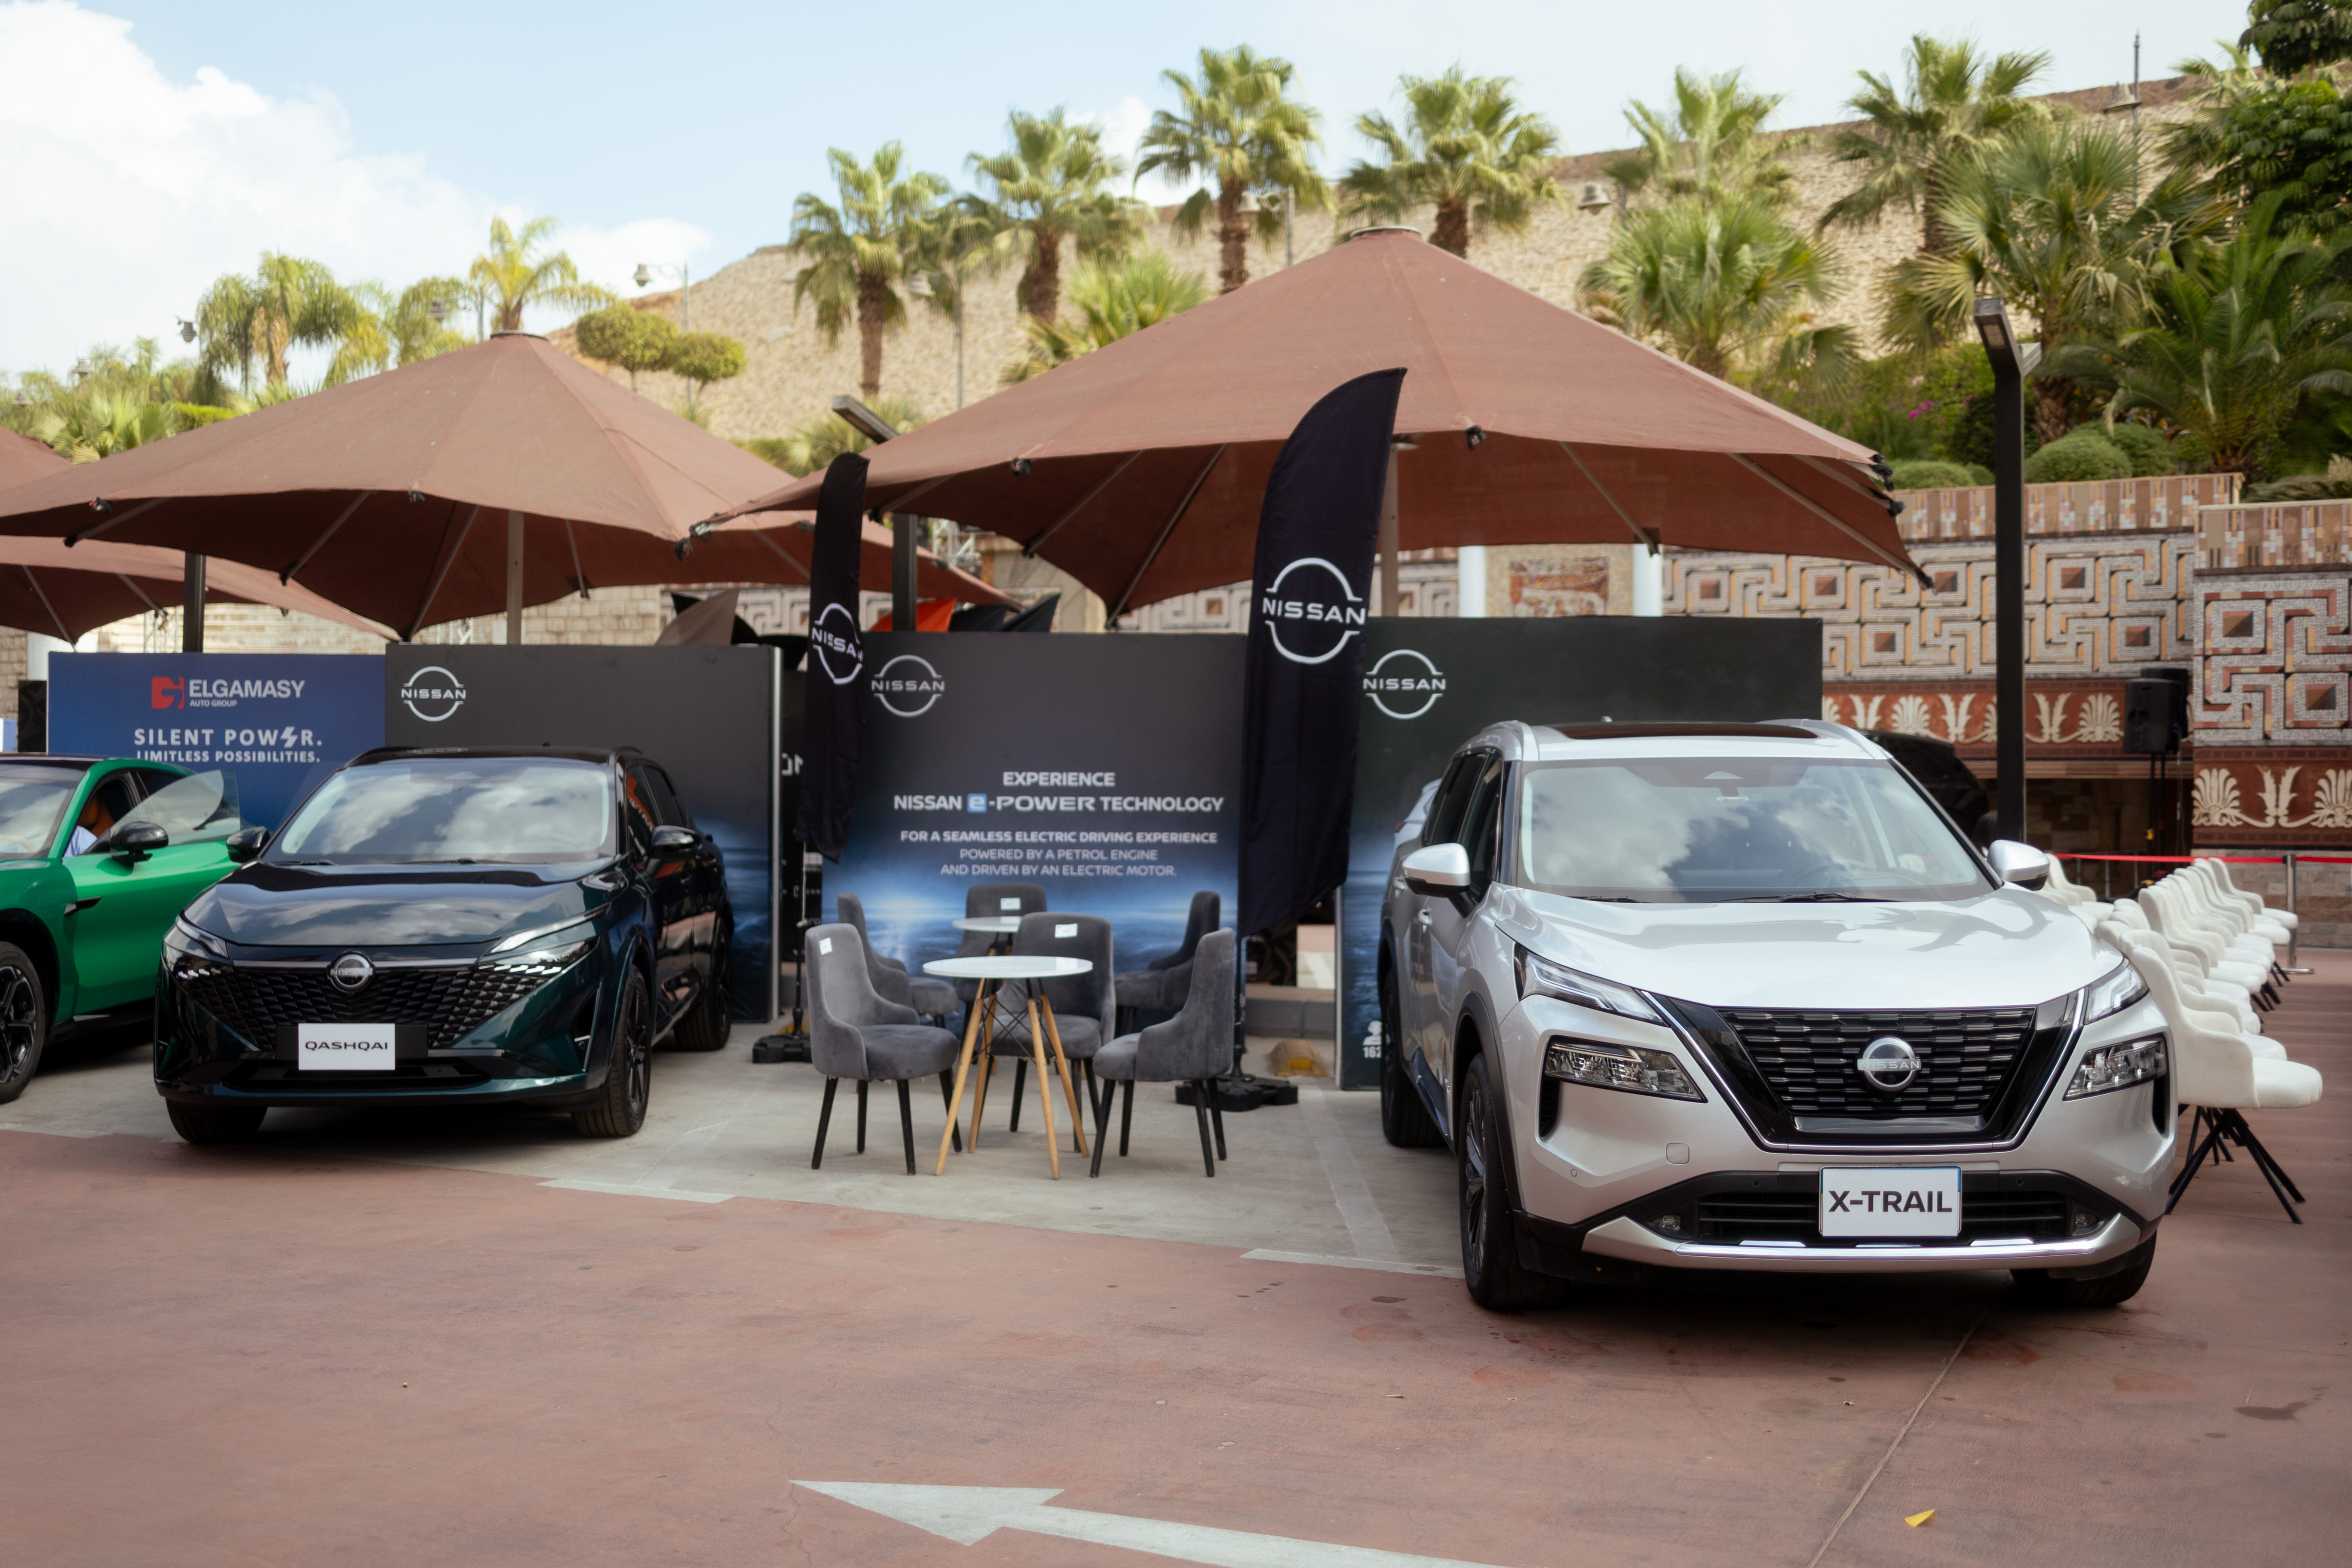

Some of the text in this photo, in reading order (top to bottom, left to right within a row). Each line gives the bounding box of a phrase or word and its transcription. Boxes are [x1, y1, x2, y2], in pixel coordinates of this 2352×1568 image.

[1262, 597, 1366, 626] NISSAN
[189, 679, 305, 699] ELGAMASY
[871, 680, 945, 691] NISSAN
[1363, 678, 1446, 690] NISSAN
[401, 688, 466, 700] NISSAN
[189, 699, 237, 708] AUTO GROUP
[134, 728, 214, 746] SILENT
[137, 750, 320, 763] LIMITLESS POSSIBILITIES.
[1003, 771, 1116, 787] EXPERIENCE
[894, 794, 1224, 812] NISSAN e-POWER TECHNOLOGY
[901, 830, 1217, 844] FOR A SEAMLESS ELECTRIC DRIVING EXPERIENCE
[960, 848, 1158, 860] POWERED BY A PETROL ENGINE
[941, 864, 1176, 876] AND DRIVEN BY AN ELECTRIC MOTOR.
[305, 1041, 387, 1051] QASHQAI
[1860, 1061, 1920, 1069] NISSAN
[1828, 1191, 1952, 1212] X-TRAIL
